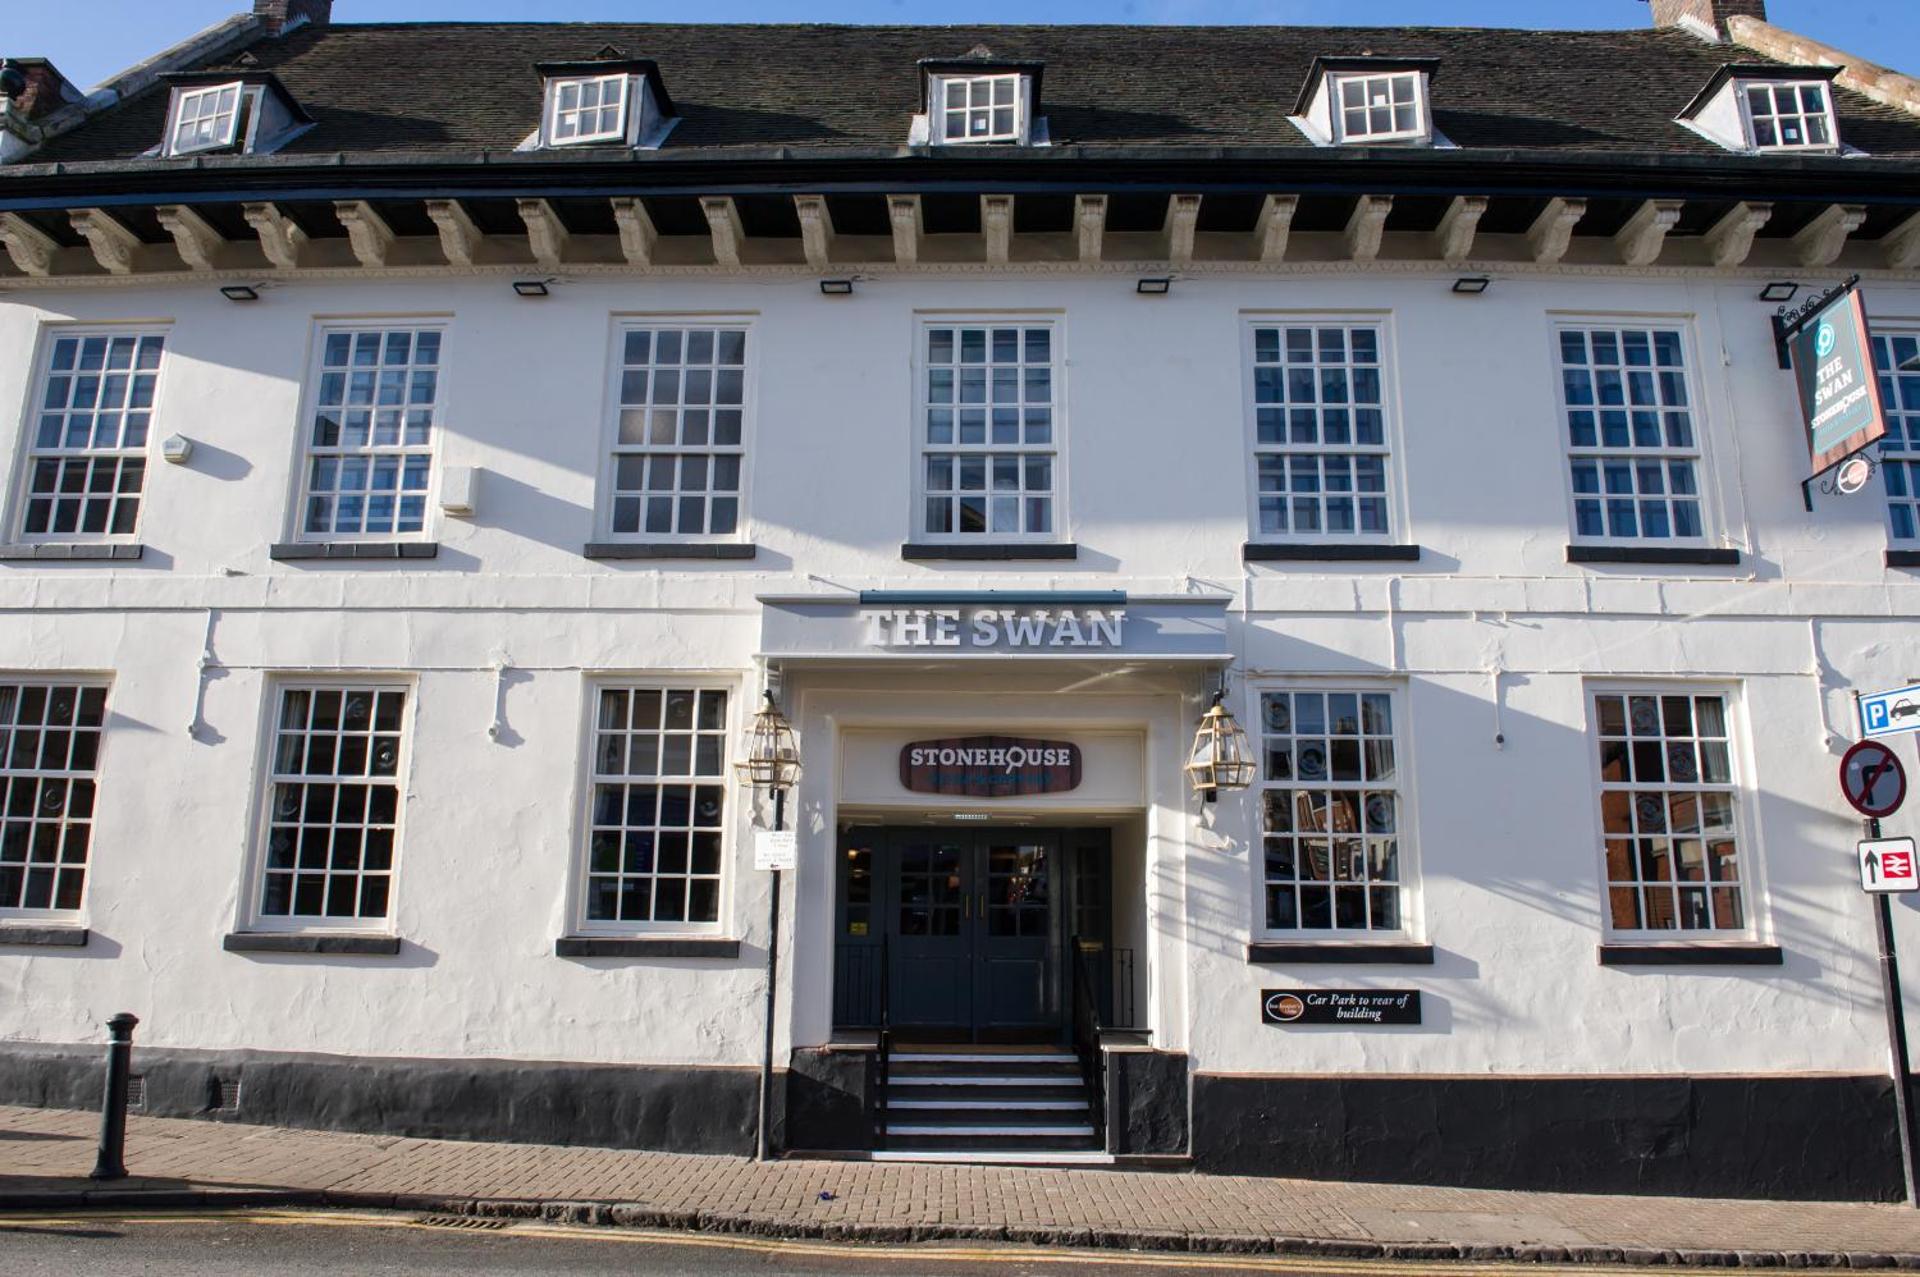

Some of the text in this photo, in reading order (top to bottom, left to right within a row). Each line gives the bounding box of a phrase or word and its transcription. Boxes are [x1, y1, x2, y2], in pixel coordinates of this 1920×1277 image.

[1816, 356, 1843, 384] THE
[1815, 368, 1853, 406] SWAN
[859, 609, 1126, 647] THE SWAN
[1870, 704, 1884, 727] P
[910, 746, 1071, 775] STONEHOUSE
[1306, 993, 1410, 1009] Car Park to rear of
[1336, 1007, 1382, 1022] building
